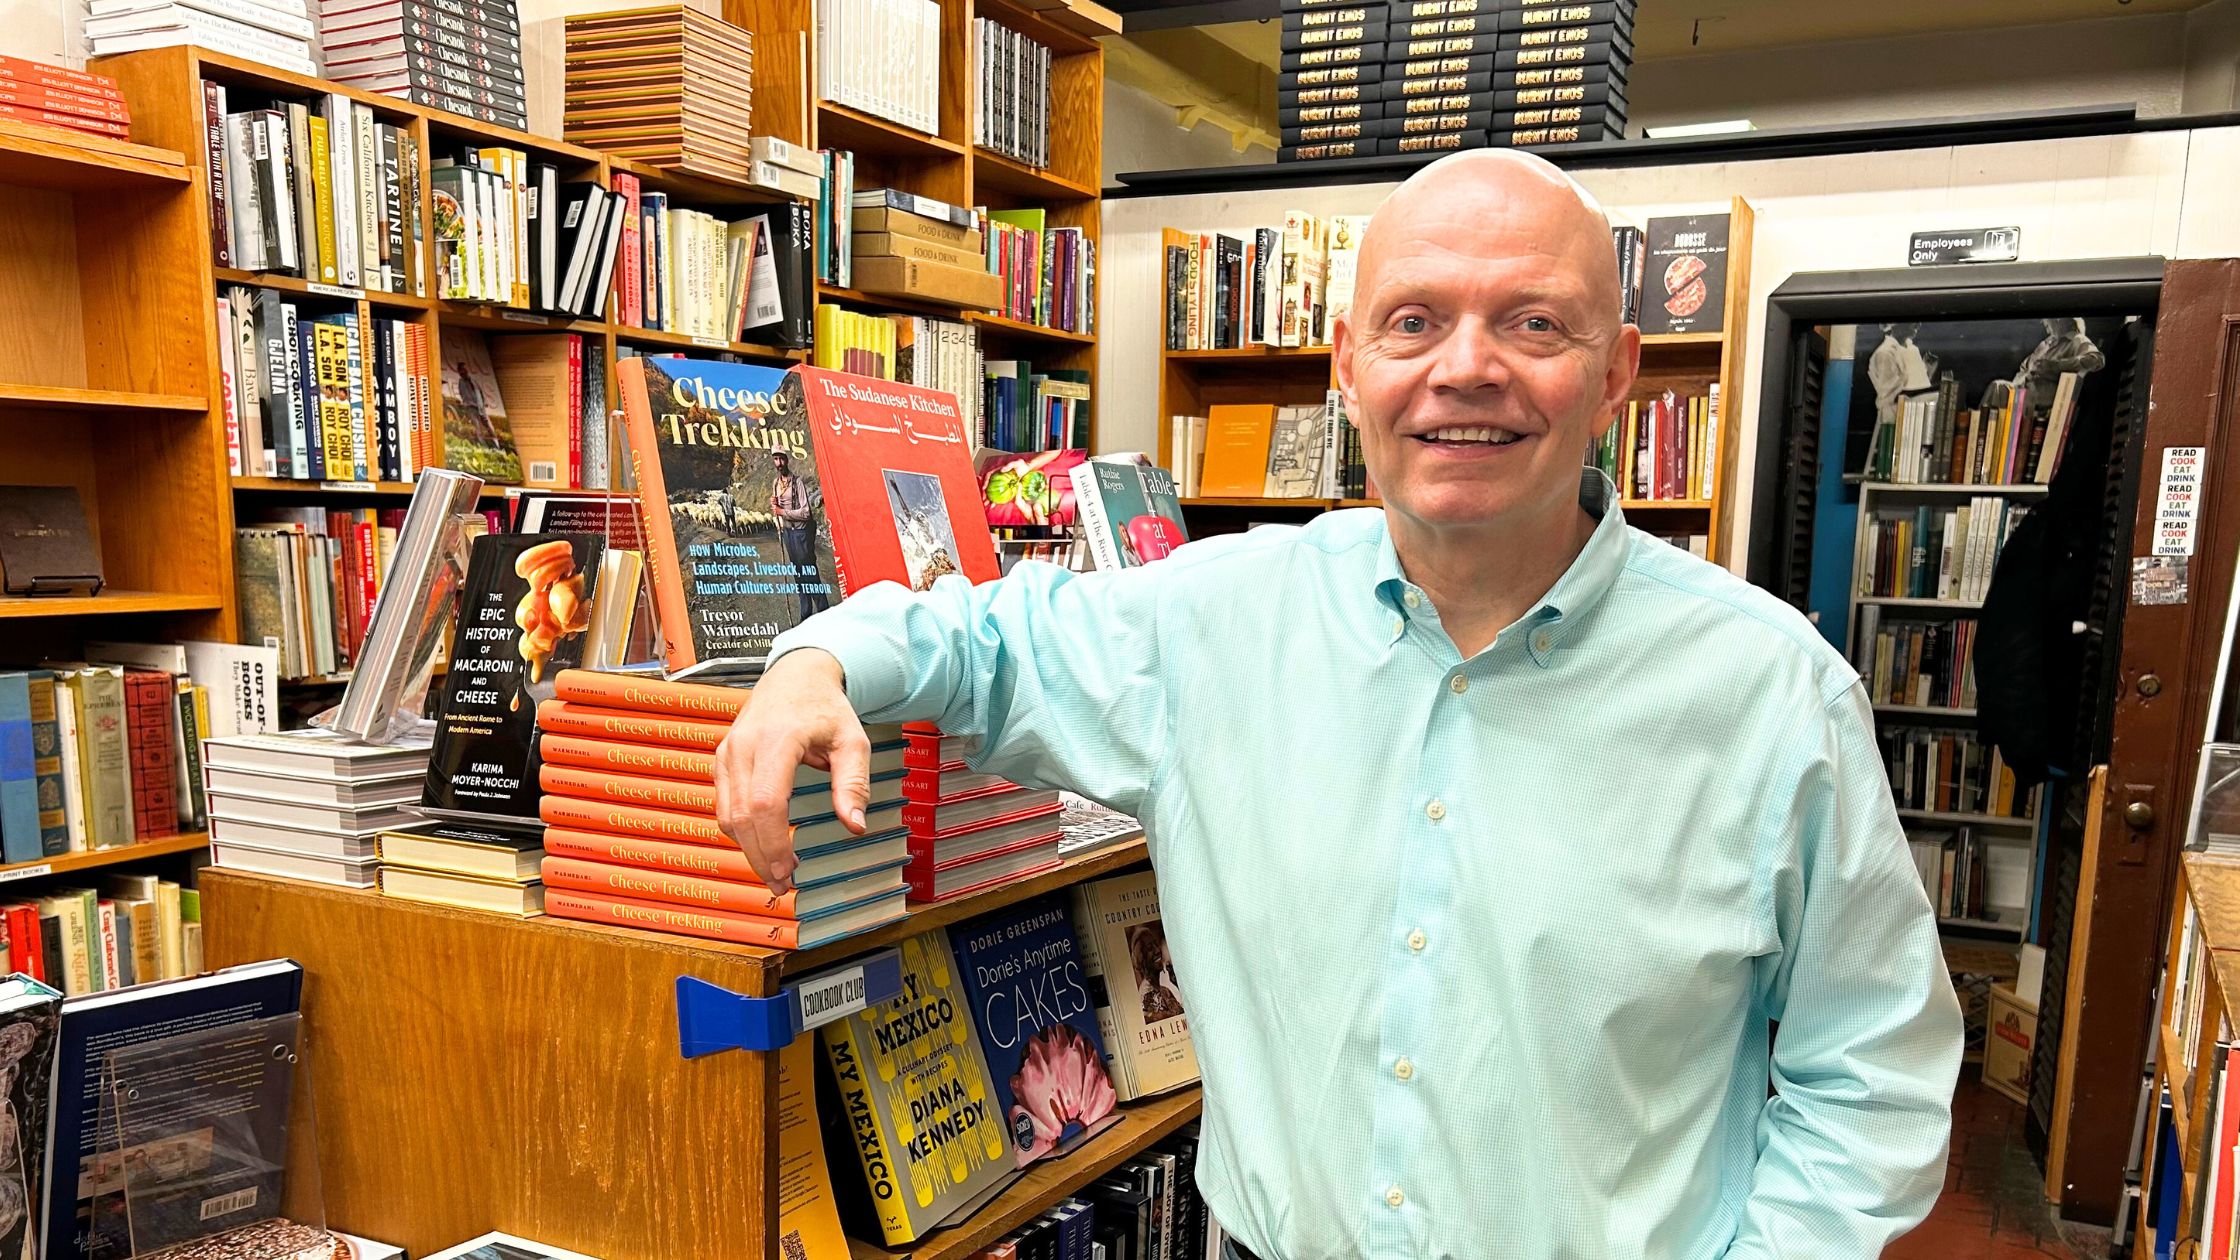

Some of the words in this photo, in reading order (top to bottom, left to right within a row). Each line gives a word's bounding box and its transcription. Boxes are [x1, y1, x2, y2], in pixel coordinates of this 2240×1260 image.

[436, 12, 466, 33] Chesnok
[1522, 9, 1559, 24] BURNT
[1560, 7, 1591, 20] ENDS
[1410, 22, 1445, 36] BURNT
[1447, 19, 1475, 32] ENDS
[438, 46, 469, 67] Chesnok
[1300, 50, 1332, 64] BURNT
[1334, 47, 1361, 61] ENDS
[1409, 41, 1444, 55] BURNT
[1445, 38, 1474, 52] ENDS
[1517, 50, 1553, 64] BURNT
[1555, 47, 1585, 61] ENDS
[440, 62, 470, 83] Chesnok
[444, 97, 473, 117] Chesnok
[1299, 108, 1332, 121] BURNT
[1333, 105, 1361, 118] ENDS
[362, 116, 370, 132] Six
[211, 127, 221, 150] TABLE
[1512, 130, 1548, 144] BURNT
[1549, 128, 1578, 142] ENDS
[316, 135, 324, 160] FULL
[212, 152, 222, 169] WITH
[362, 135, 374, 191] California
[318, 162, 327, 187] BELLY
[214, 178, 224, 200] VIEW
[320, 188, 328, 211] FARM
[364, 192, 376, 234] Kitchens
[386, 158, 402, 248] TARTINE
[792, 208, 800, 248] BOKA
[802, 210, 811, 250] BOKA
[918, 224, 936, 235] FOOD
[944, 230, 961, 242] DRINK
[322, 225, 332, 264] KITCHEN
[1914, 238, 1973, 250] Employees
[914, 248, 933, 258] FOOD
[940, 252, 959, 264] DRINK
[1913, 250, 1938, 261] Only
[319, 328, 329, 353] L.A.
[333, 331, 344, 354] L.A.
[268, 339, 287, 395] GJELINA
[307, 352, 316, 388] SPACCA
[322, 356, 332, 380] SON
[336, 360, 347, 382] SON
[346, 328, 360, 406] CALI-BAJA
[244, 369, 260, 404] Bavel
[290, 360, 304, 430] COOKING
[672, 376, 788, 415] Cheese
[820, 378, 847, 398] The
[848, 383, 908, 409] Sudanese
[908, 394, 956, 417] Kitchen
[222, 371, 238, 450] Coastal
[324, 406, 336, 430] ROY
[338, 408, 349, 431] ROY
[386, 376, 397, 458] AMBOY
[830, 402, 902, 435] السوداني
[352, 410, 366, 467] CUISINE
[660, 413, 807, 460] Trekking
[904, 414, 962, 446] المطبخ
[326, 434, 338, 460] CHOI
[340, 434, 351, 462] CHOI
[632, 449, 647, 508] Cheese
[1100, 468, 1120, 479] Ruthie
[1138, 472, 1173, 495] Table
[1103, 480, 1125, 494] Rogers
[1080, 474, 1091, 498] Table
[1089, 509, 1096, 518] at
[1093, 520, 1102, 537] The
[1098, 539, 1109, 563] River
[1148, 497, 1156, 518] 4
[2163, 510, 2191, 518] DRINK
[1153, 522, 1166, 539] at
[690, 544, 710, 556] HOW
[714, 542, 760, 558] Microbes,
[693, 562, 753, 577] Landscapes,
[754, 562, 800, 577] Livestock,
[802, 566, 816, 576] AND
[489, 593, 503, 601] THE
[696, 582, 733, 594] Human
[734, 582, 774, 594] Cultures
[776, 584, 800, 594] SHAPE
[801, 584, 832, 594] TERROIR
[480, 609, 505, 620] EPIC
[700, 610, 744, 622] Trevor
[466, 628, 514, 640] HISTORY
[701, 623, 779, 636] Warmedahl
[706, 639, 741, 650] Creator
[743, 638, 752, 648] of
[454, 659, 513, 672] MACARONI
[241, 661, 253, 720] BOOKS
[471, 677, 487, 685] AND
[456, 690, 498, 704] CHEESE
[625, 688, 674, 706] Cheese
[678, 694, 738, 716] Trekking
[444, 713, 457, 721] From
[458, 714, 478, 722] Ancient
[479, 715, 495, 723] Rome
[184, 703, 196, 757] WORKING
[449, 726, 468, 734] Modern
[470, 727, 492, 735] America
[915, 748, 929, 756] ART
[472, 763, 503, 774] KARIMA
[452, 775, 519, 789] MOYER-NOCCHI
[605, 782, 651, 800] Cheese
[655, 788, 713, 809] Trekking
[1066, 800, 1084, 809] Cafe
[913, 816, 925, 824] ART
[610, 844, 656, 863] Cheese
[660, 850, 719, 873] Trekking
[1118, 892, 1131, 902] THE
[1132, 890, 1151, 900] TASTE
[101, 911, 112, 933] Craig
[612, 904, 660, 923] Cheese
[663, 910, 723, 933] Trekking
[1105, 907, 1142, 924] COUNTRY
[970, 930, 1003, 953] DORIE
[1006, 909, 1064, 939] GREENSPAN
[977, 953, 1022, 988] Dorie's
[1023, 937, 1072, 970] Anytime
[804, 983, 844, 1018] COOKBOOK
[845, 977, 864, 1002] CLUB
[986, 960, 1087, 1049] CAKES
[874, 998, 953, 1056] MEXICO
[1139, 1027, 1165, 1044] EDNA
[902, 1056, 929, 1074] CULINARY
[930, 1043, 953, 1061] ODYSSEY
[910, 1073, 925, 1085] WITH
[926, 1060, 948, 1076] RECIPES
[910, 1078, 966, 1124] DIANA
[831, 1040, 859, 1082] MY
[846, 1089, 893, 1200] MEXICO
[907, 1099, 986, 1164] KENNEDY
[1166, 1169, 1174, 1184] THE
[1164, 1216, 1171, 1229] OF
